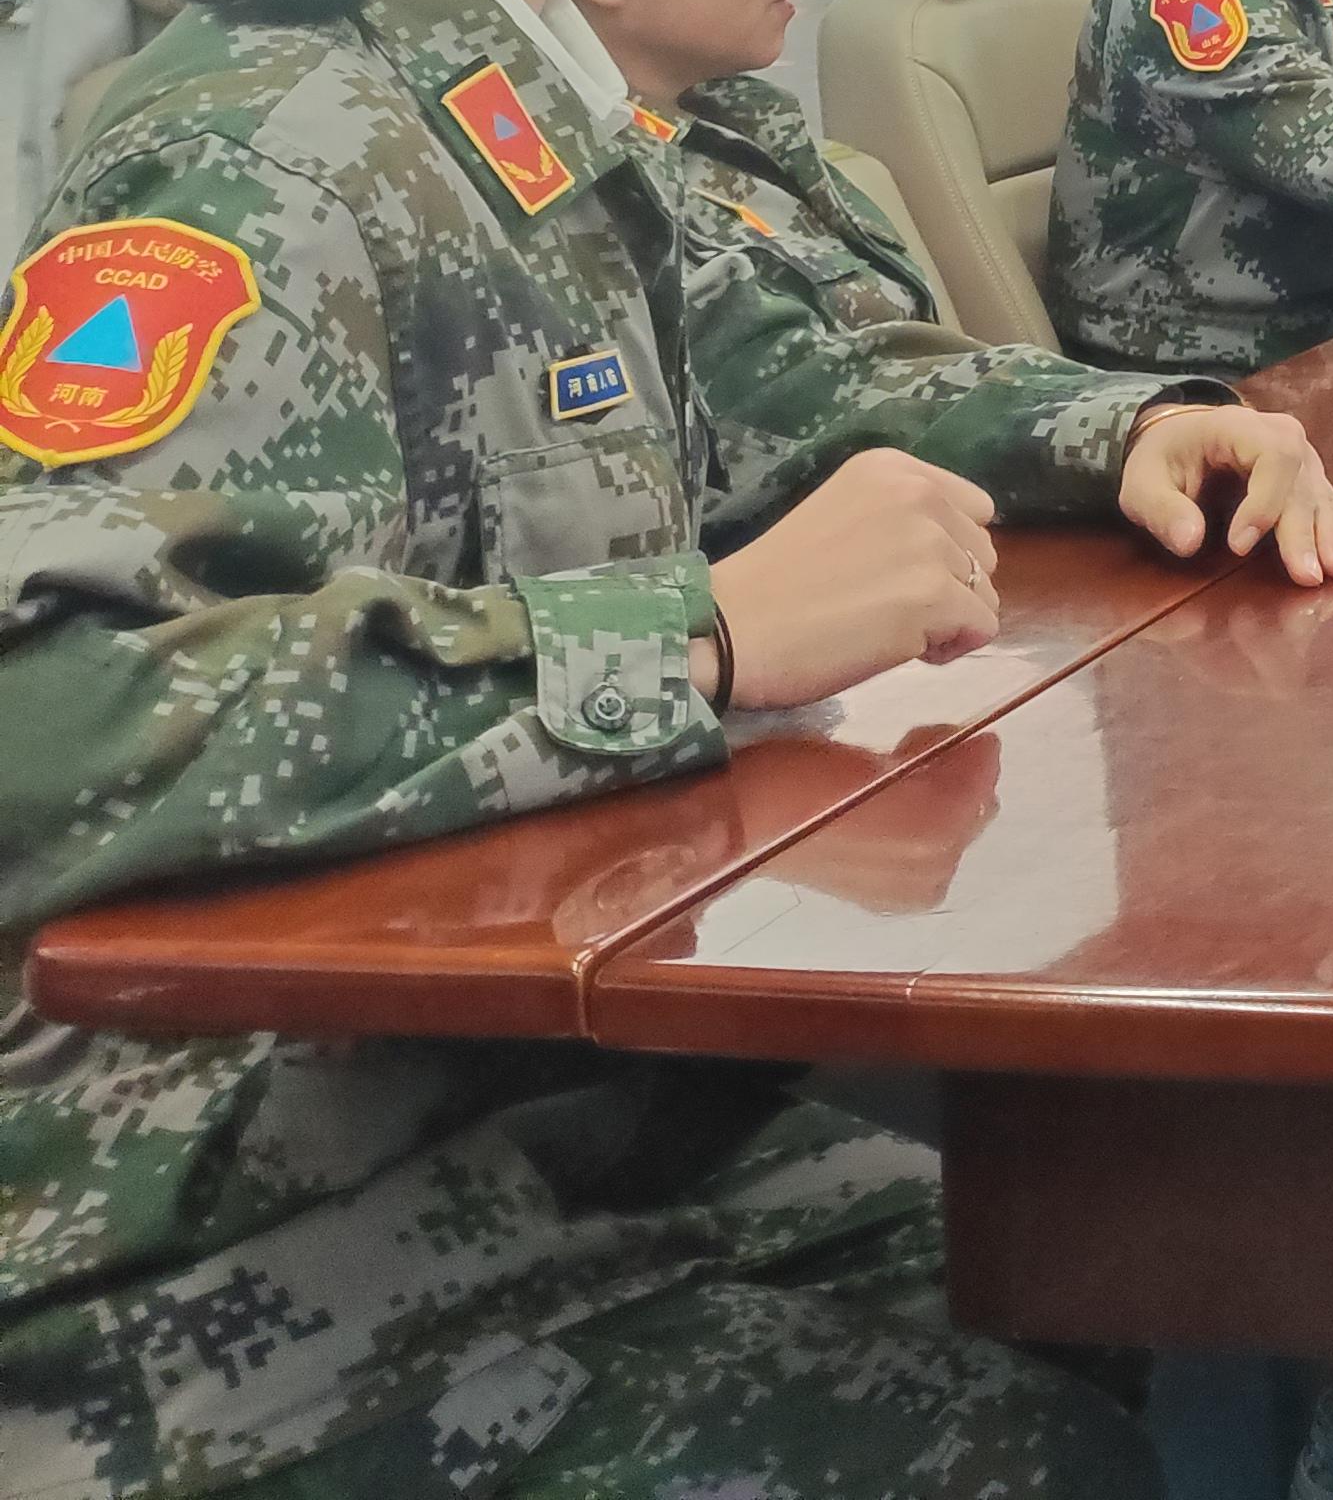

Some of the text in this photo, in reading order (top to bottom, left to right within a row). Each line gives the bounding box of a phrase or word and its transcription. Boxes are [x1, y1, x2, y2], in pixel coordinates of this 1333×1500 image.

[57, 238, 223, 285] 中国人民防空
[95, 267, 169, 290] CCAD
[49, 383, 108, 408] 河南
